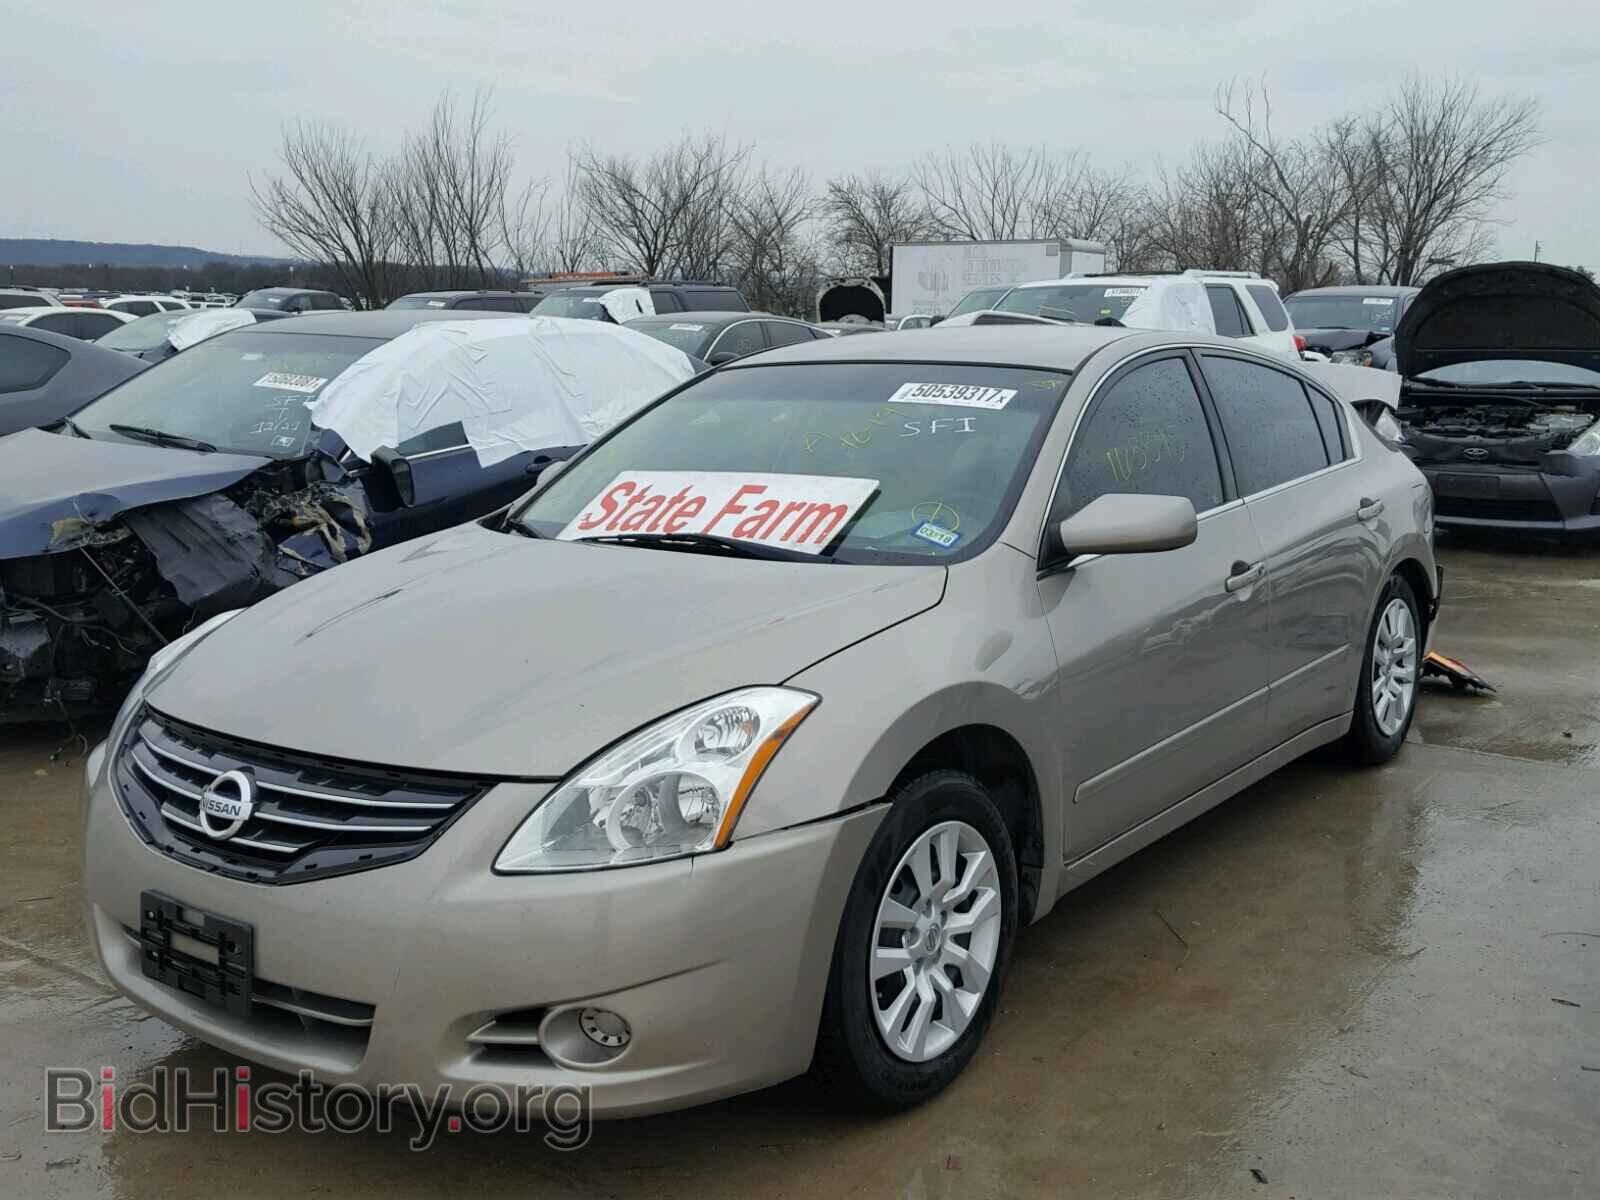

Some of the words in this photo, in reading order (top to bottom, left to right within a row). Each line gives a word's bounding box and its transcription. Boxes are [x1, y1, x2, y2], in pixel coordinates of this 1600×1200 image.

[899, 417, 977, 437] SFI
[577, 481, 708, 534] State
[704, 484, 849, 545] Farm
[201, 797, 242, 816] NISSAN
